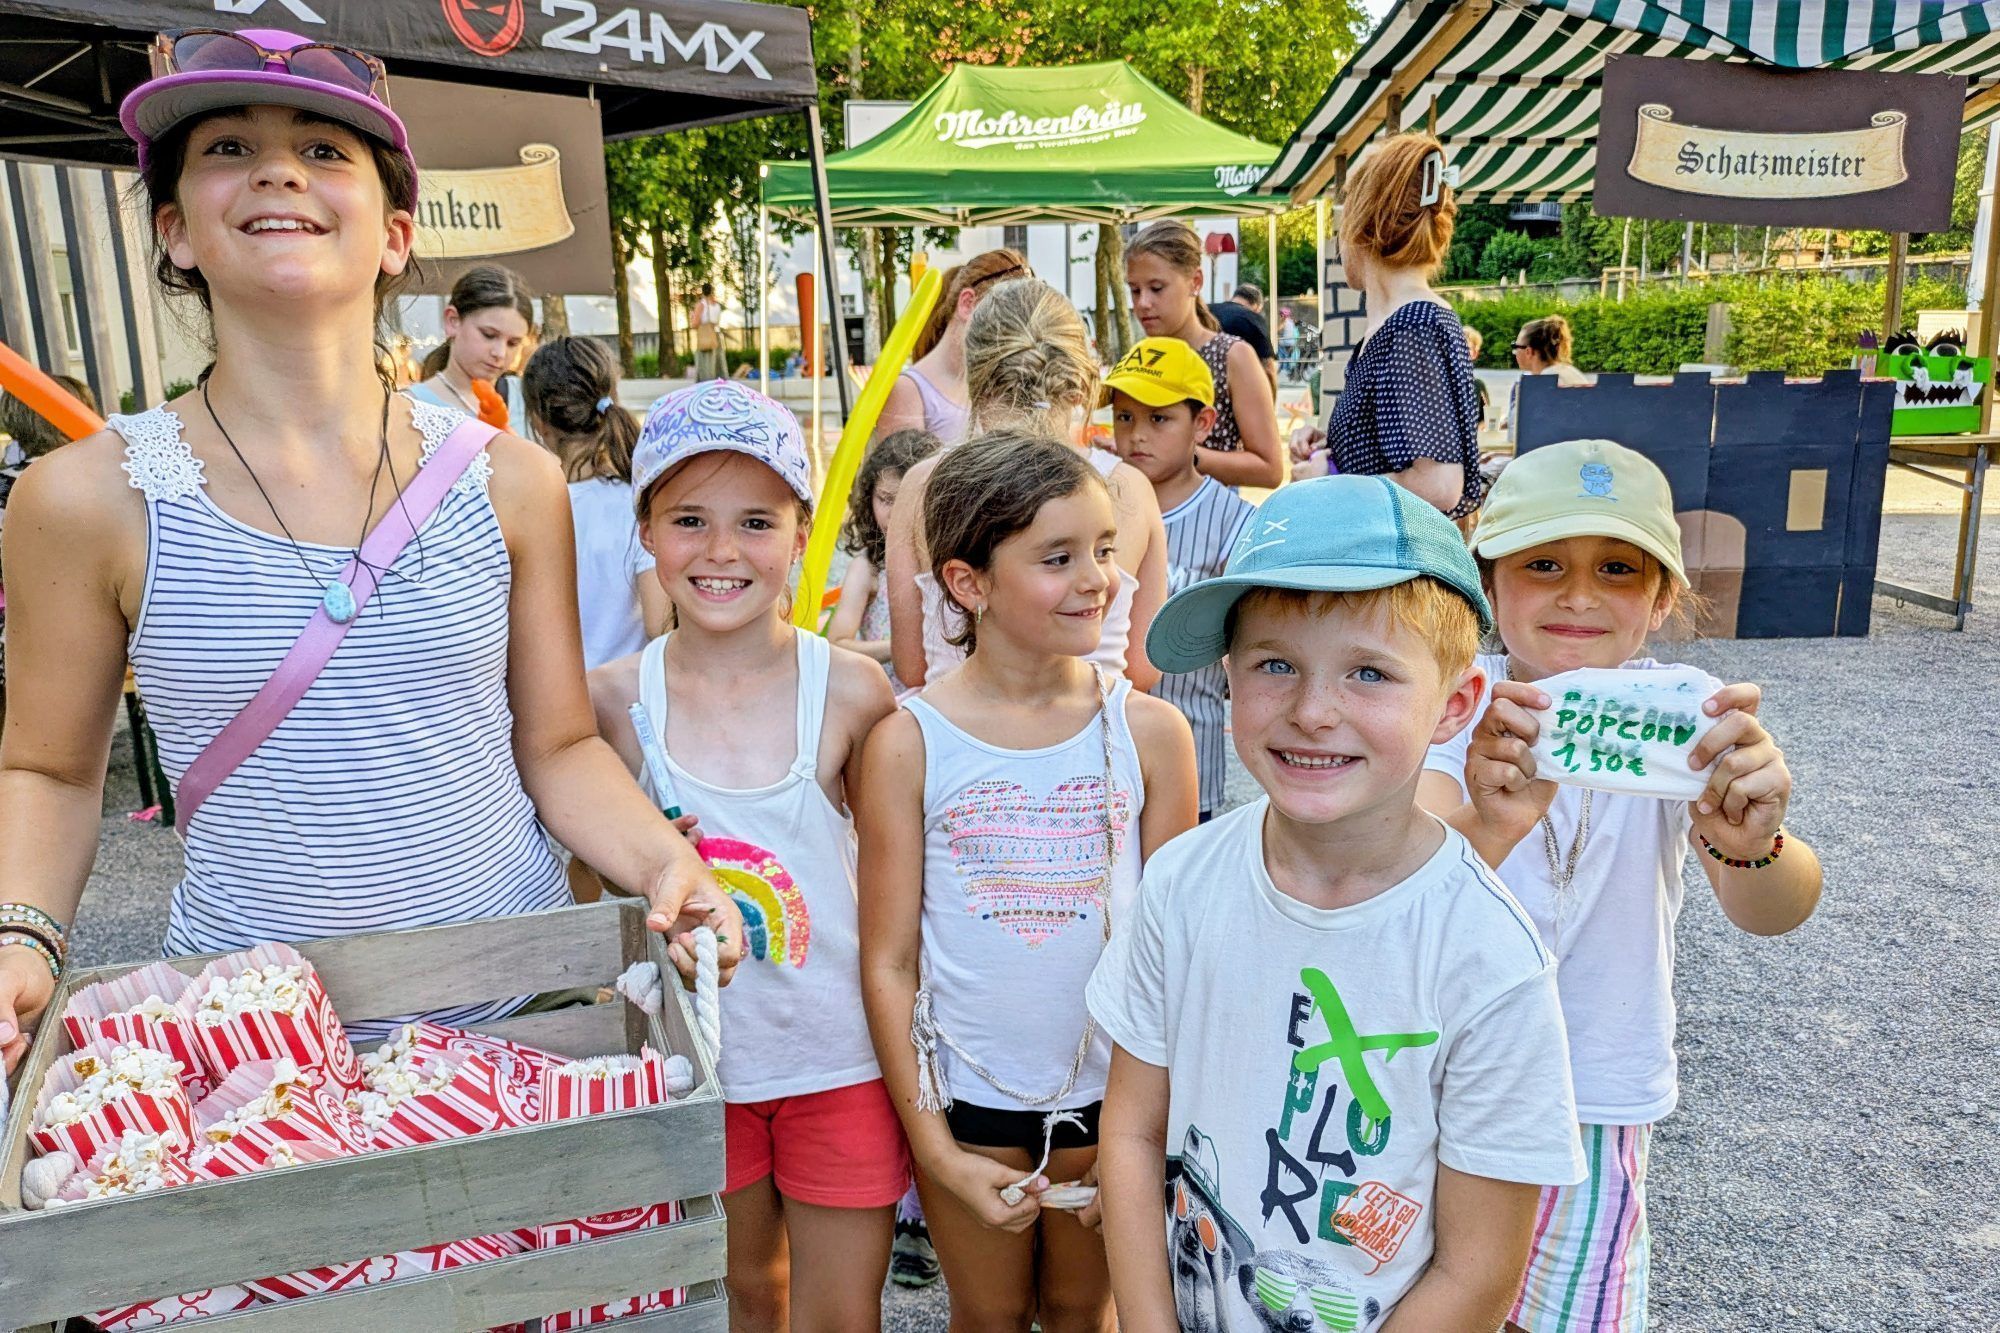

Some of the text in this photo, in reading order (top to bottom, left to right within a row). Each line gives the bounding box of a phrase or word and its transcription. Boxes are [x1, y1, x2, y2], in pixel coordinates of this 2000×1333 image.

[541, 0, 773, 80] 24MX
[934, 101, 1147, 141] Mohrenbräu
[1214, 163, 1270, 189] Mohr
[1675, 140, 1866, 181] Schatzmeister
[417, 189, 502, 229] inken
[1556, 709, 1697, 746] POPCORN
[1552, 742, 1647, 776] 1,50€
[348, 1113, 369, 1148] COR
[1357, 1203, 1403, 1239] ON AN
[1364, 1185, 1416, 1225] LET'S GO
[1337, 1211, 1398, 1257] ADVENTURE
